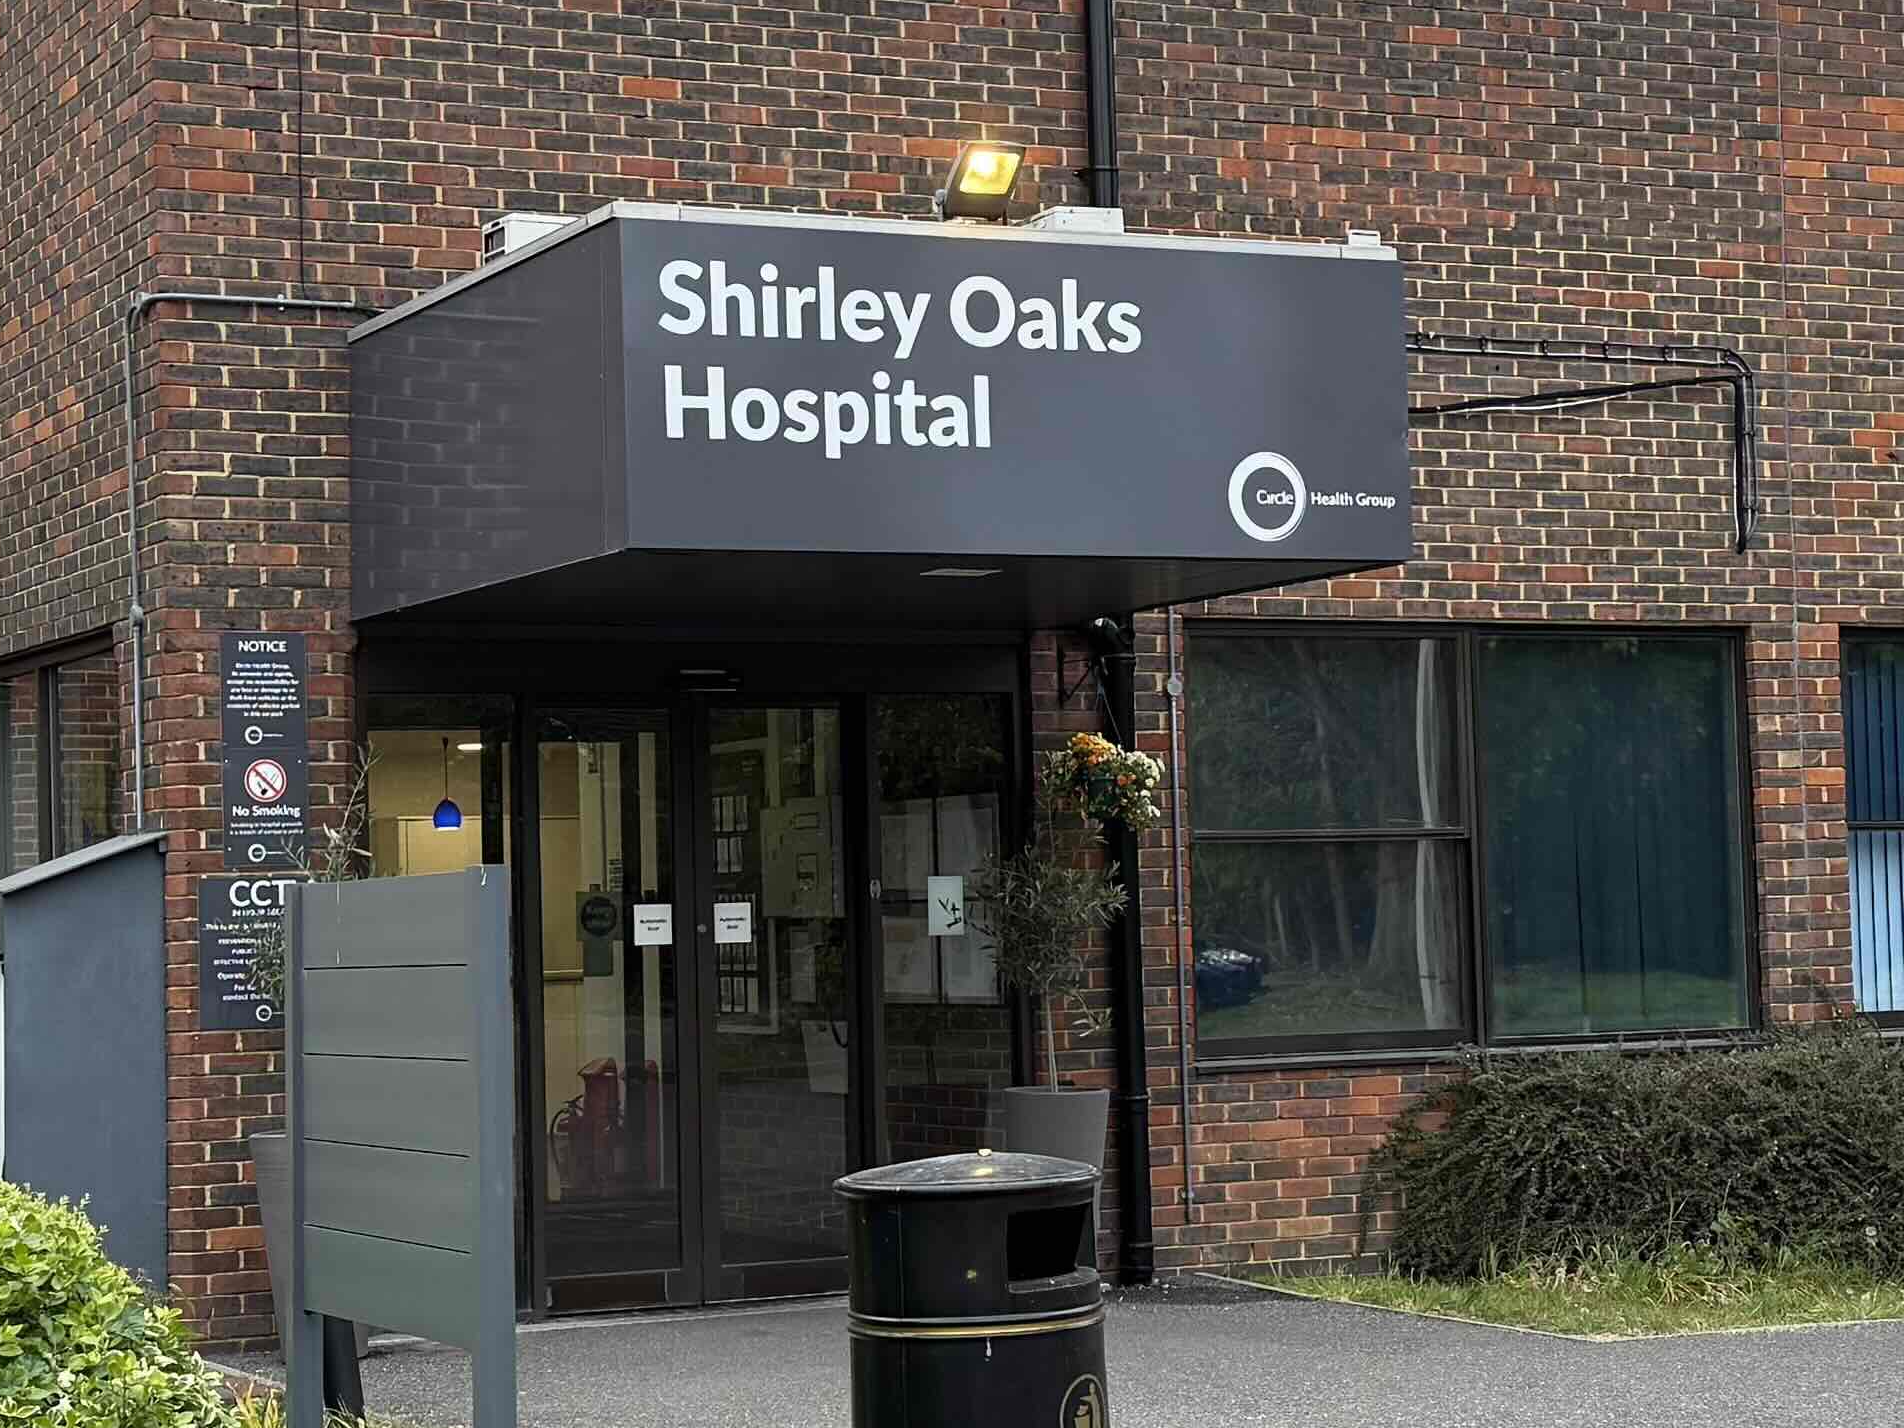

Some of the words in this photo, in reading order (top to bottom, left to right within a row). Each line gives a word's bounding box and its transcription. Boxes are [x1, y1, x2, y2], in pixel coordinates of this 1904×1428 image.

[657, 259, 932, 360] Shirley
[949, 275, 1142, 354] Oaks
[663, 364, 992, 460] Hospital
[1256, 489, 1295, 505] Circle
[1310, 491, 1353, 507] Health
[1355, 492, 1396, 509] Group
[238, 640, 287, 652] NOTICE
[232, 805, 250, 817] No
[252, 804, 301, 818] Smoking
[229, 879, 297, 907] CCT
